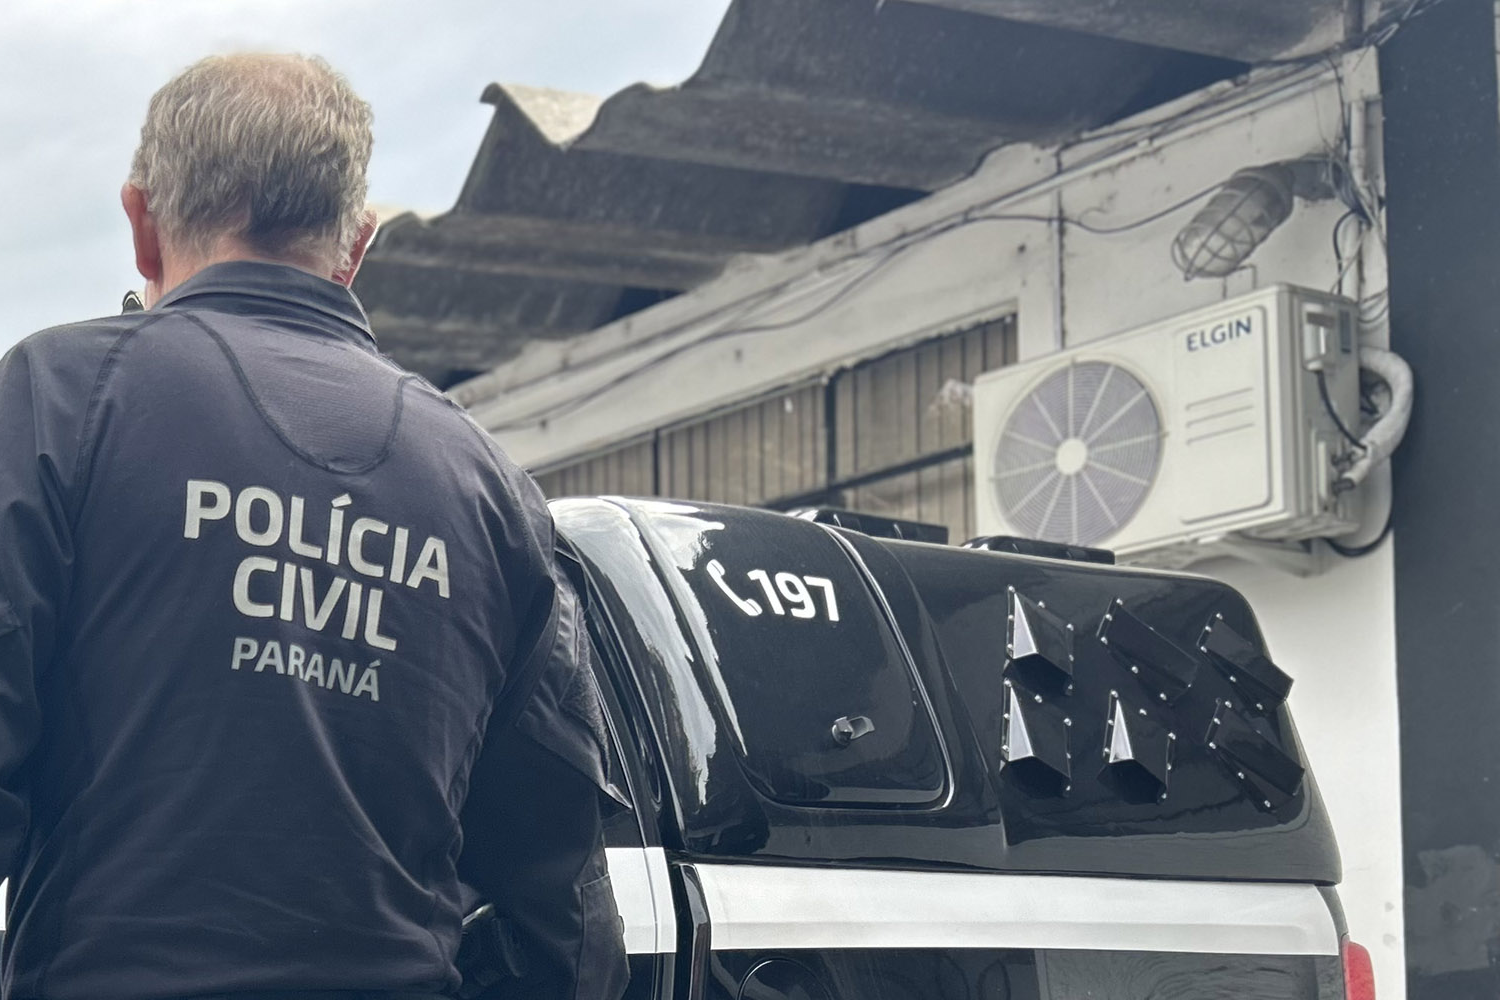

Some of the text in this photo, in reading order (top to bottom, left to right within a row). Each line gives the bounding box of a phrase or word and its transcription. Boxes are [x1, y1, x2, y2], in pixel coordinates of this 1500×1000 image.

[1186, 316, 1252, 351] ELGIN
[184, 479, 450, 599] POLÍCIA
[233, 556, 397, 651] CIVIL
[747, 569, 839, 622] 197
[231, 637, 381, 701] PARANÁ
